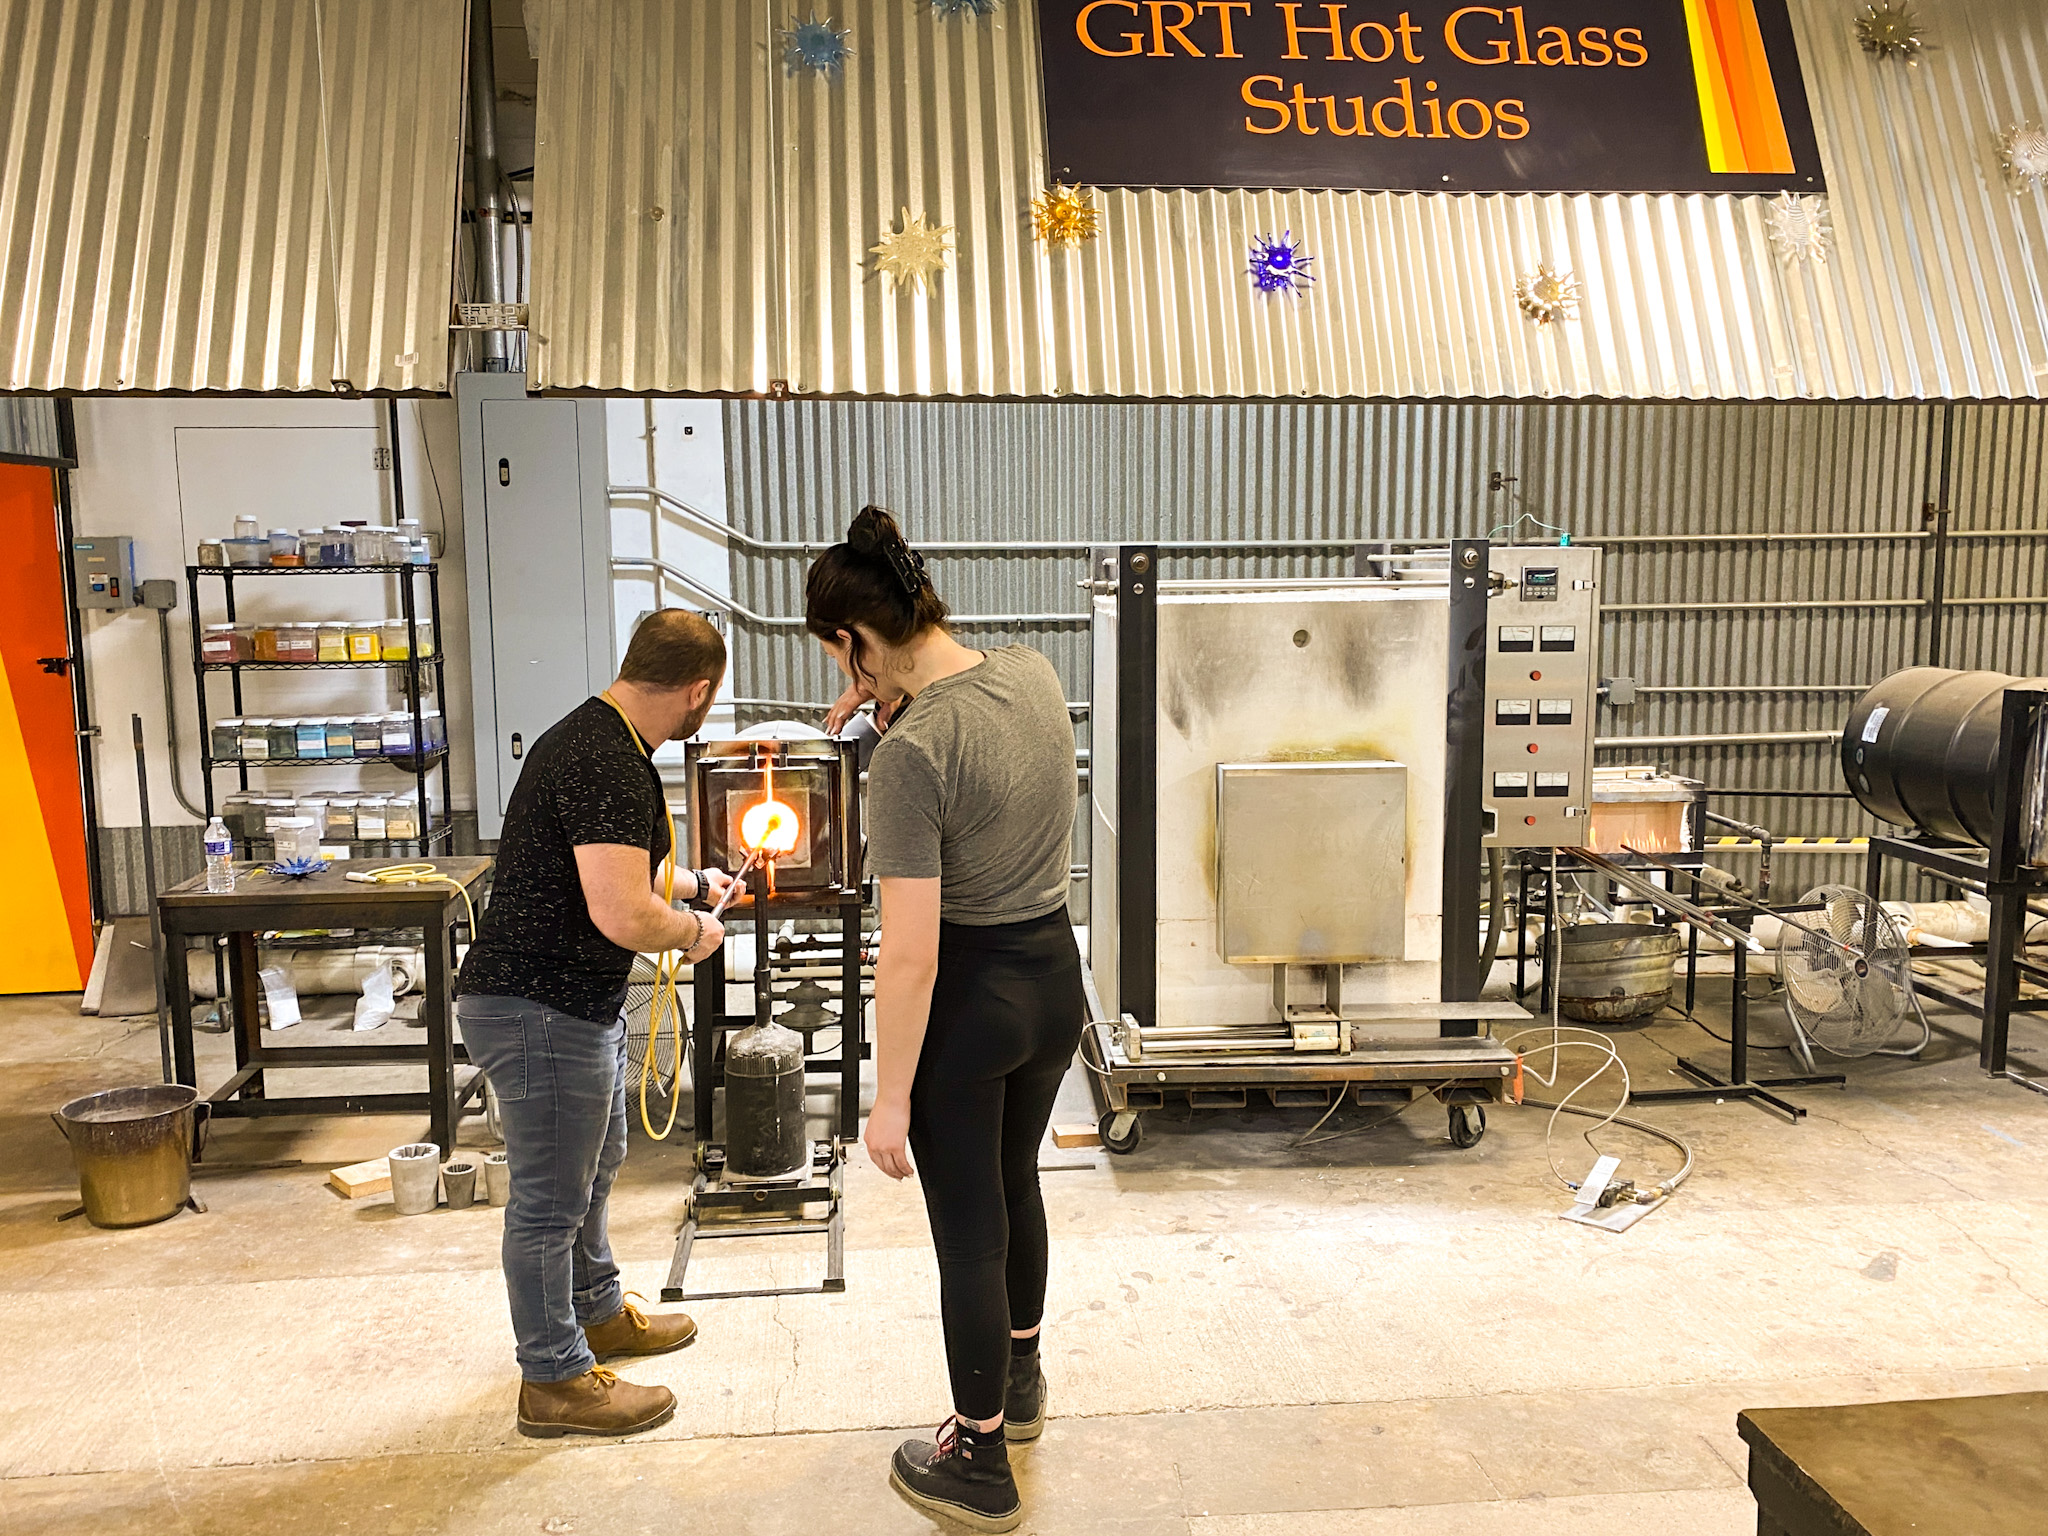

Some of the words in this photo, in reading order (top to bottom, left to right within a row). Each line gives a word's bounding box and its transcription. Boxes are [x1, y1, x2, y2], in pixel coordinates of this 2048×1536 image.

[1075, 0, 1252, 58] GRT
[1274, 3, 1425, 63] Hot
[1444, 6, 1649, 67] Glass
[1241, 75, 1531, 140] Studios
